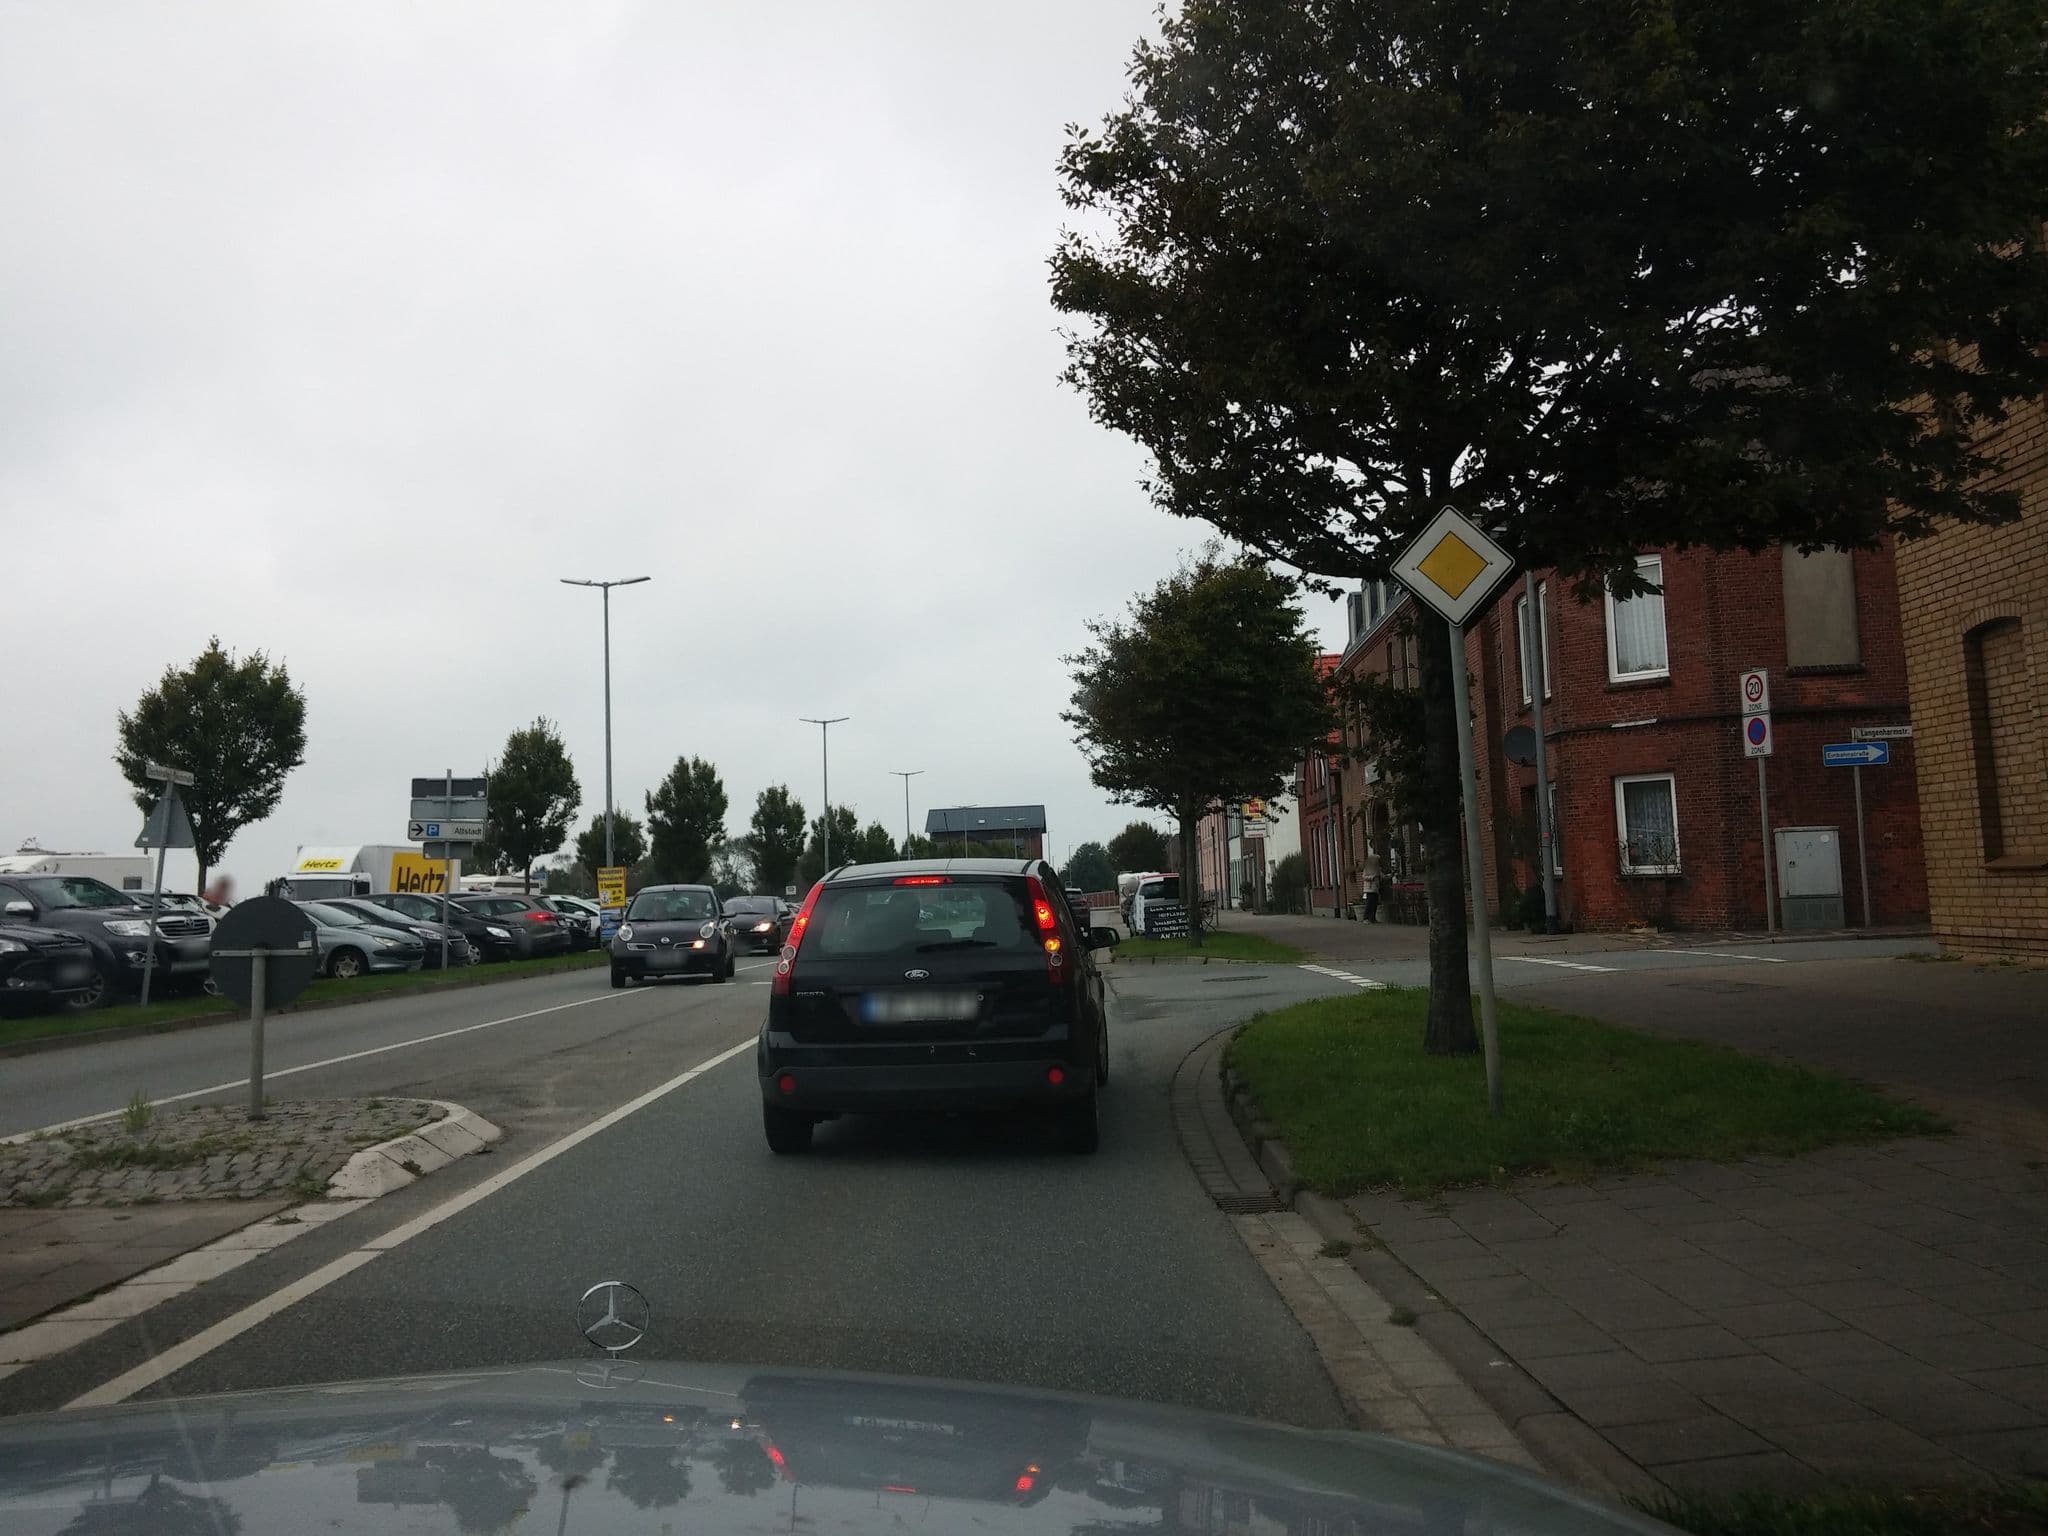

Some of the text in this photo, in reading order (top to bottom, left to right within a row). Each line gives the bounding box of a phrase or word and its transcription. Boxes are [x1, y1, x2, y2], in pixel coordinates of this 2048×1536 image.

[1749, 682, 1759, 695] 20
[1748, 702, 1763, 711] ZONE
[1861, 728, 1910, 737] Langenharmstr.
[1751, 746, 1766, 754] ZONE
[428, 824, 482, 835] P Altstadt
[304, 860, 338, 868] Hertz
[397, 866, 446, 893] Hertz
